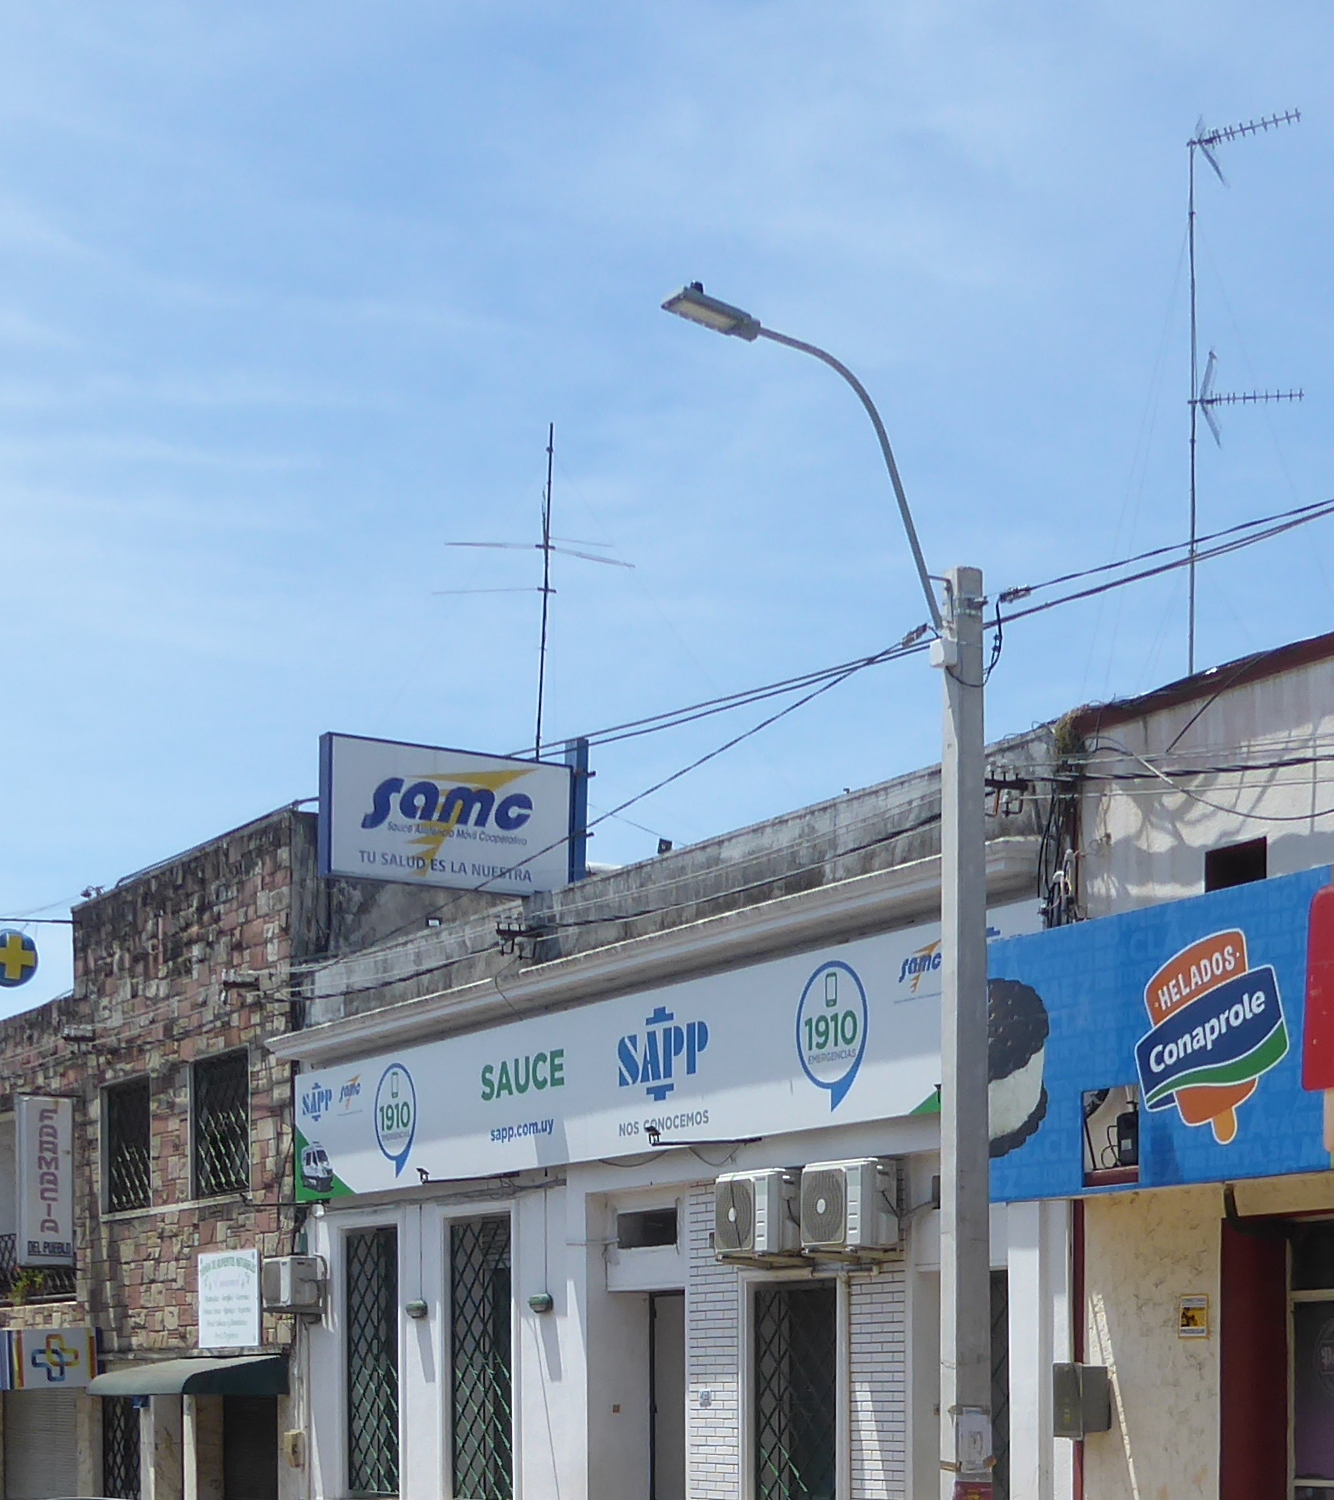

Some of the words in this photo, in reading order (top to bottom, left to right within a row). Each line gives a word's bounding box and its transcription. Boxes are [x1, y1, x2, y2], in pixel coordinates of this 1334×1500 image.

[361, 777, 534, 831] samc
[359, 850, 377, 864] TU
[381, 852, 426, 870] SALUD
[430, 858, 446, 872] ES
[451, 861, 466, 876] LA
[471, 863, 533, 883] NUESTRA
[1158, 945, 1235, 1011] HELADOS
[804, 1010, 858, 1051] 1910
[1149, 990, 1266, 1073] Conaprole
[617, 1019, 709, 1088] SAPP
[807, 1049, 857, 1065] EMERGENCIAS
[481, 1048, 565, 1101] SAUCE
[302, 1088, 333, 1116] SAPP
[379, 1101, 411, 1131] 1910
[490, 1118, 555, 1144] sapp.com.uy
[619, 1121, 640, 1137] NOS
[37, 1107, 60, 1235] FARMACIA
